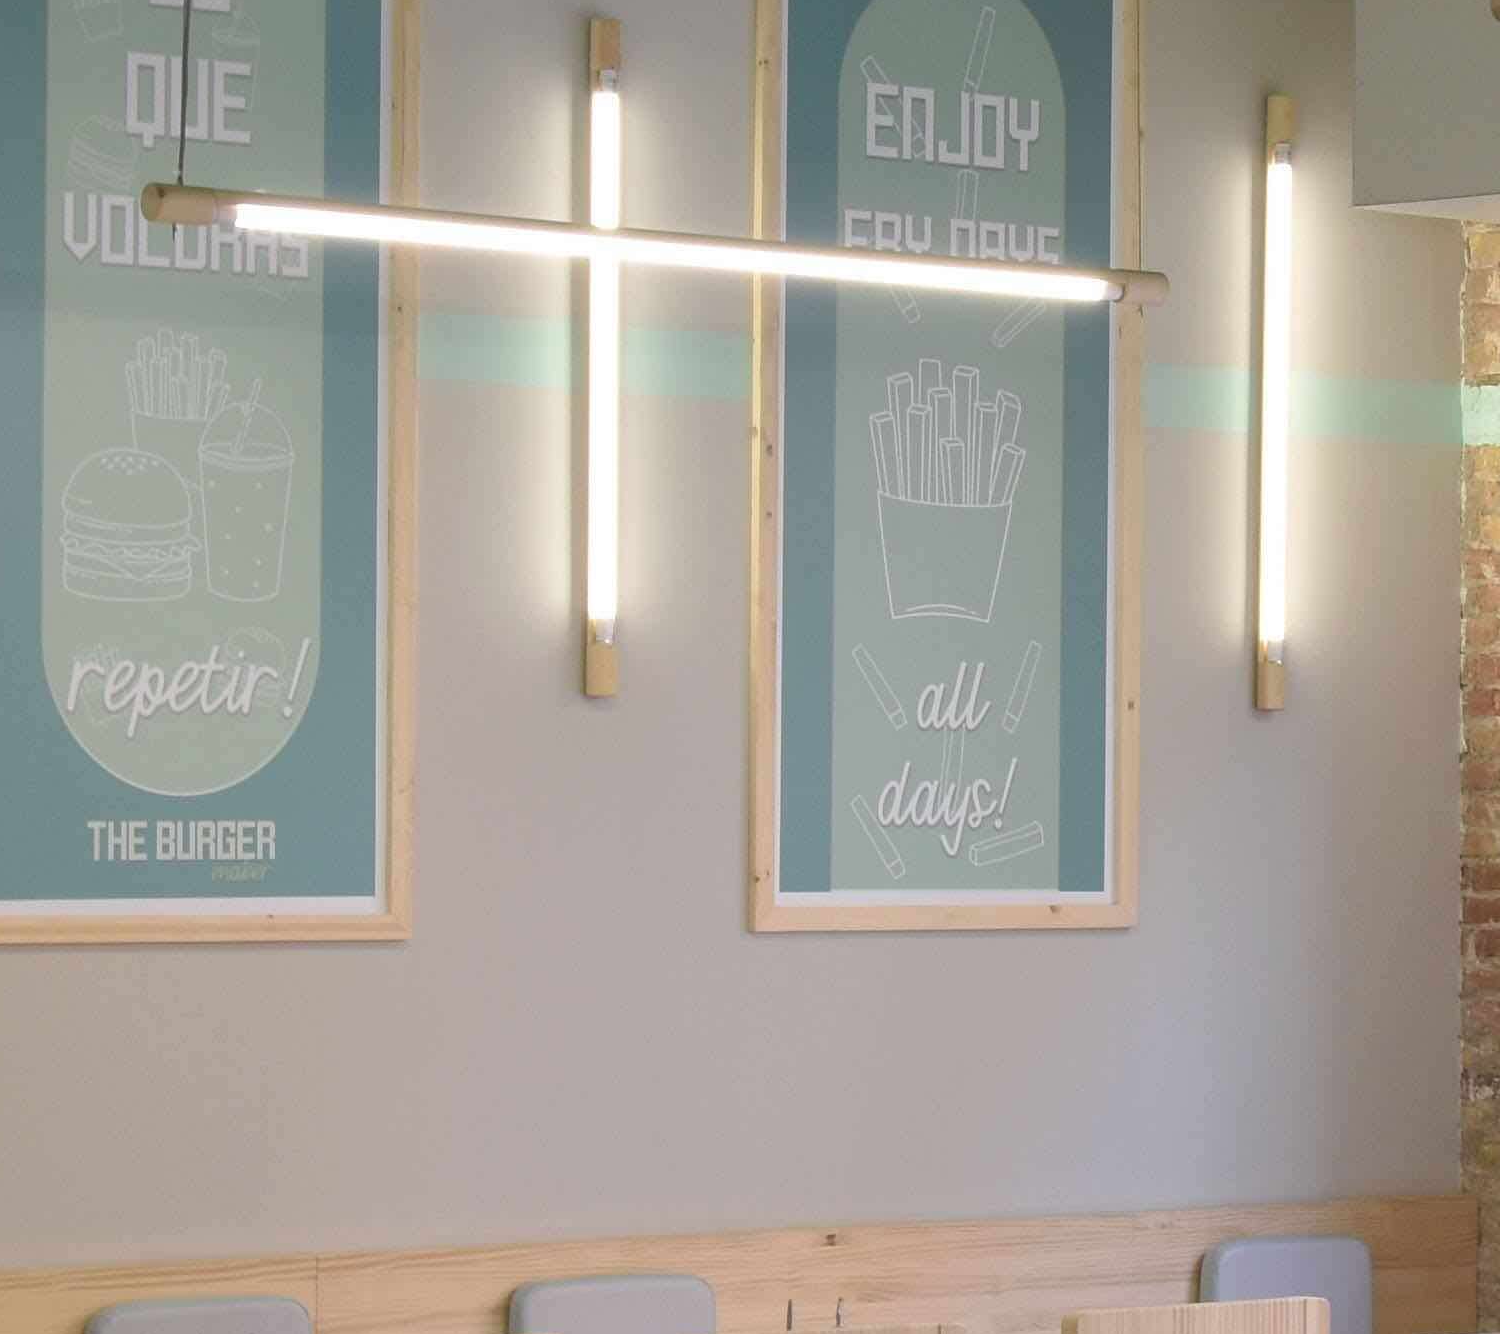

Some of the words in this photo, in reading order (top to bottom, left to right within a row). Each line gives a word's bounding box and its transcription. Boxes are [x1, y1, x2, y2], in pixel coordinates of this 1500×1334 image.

[126, 51, 252, 148] QUE
[866, 82, 1041, 172] ENJOY
[66, 637, 310, 737] repetir!
[917, 662, 991, 730] all
[87, 820, 148, 861] THE
[156, 820, 276, 861] BURGER
[878, 757, 1017, 856] days!
